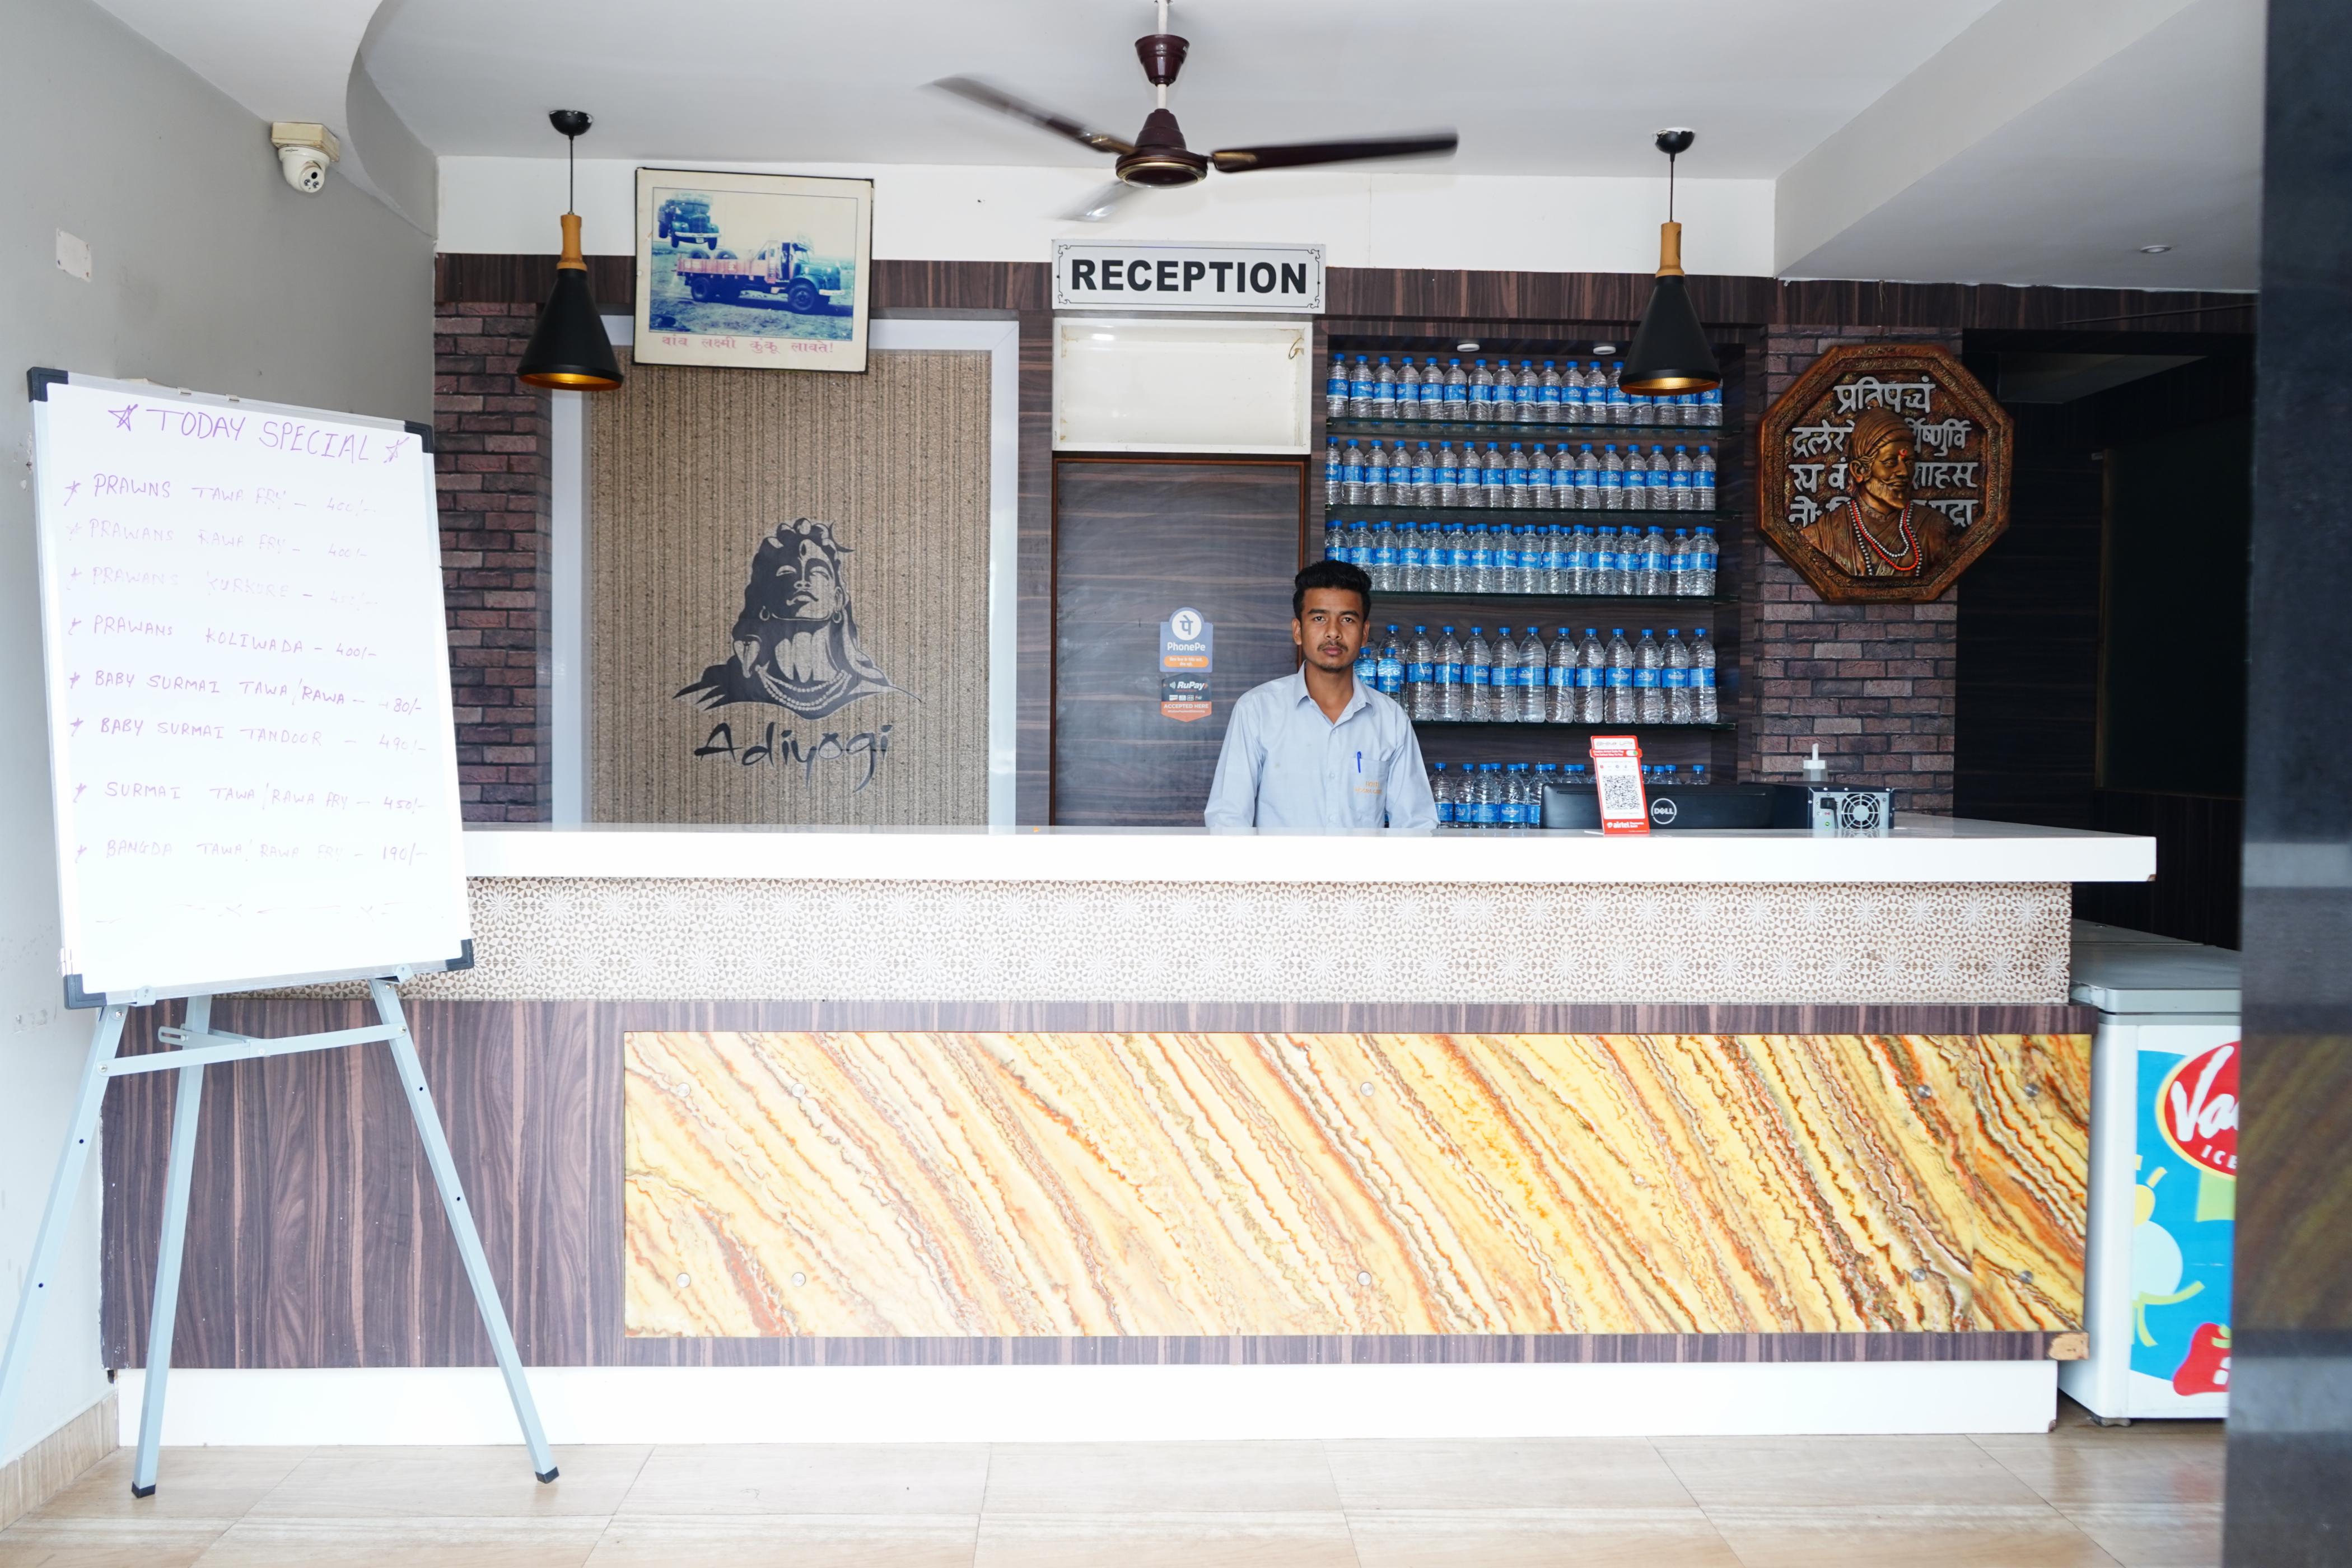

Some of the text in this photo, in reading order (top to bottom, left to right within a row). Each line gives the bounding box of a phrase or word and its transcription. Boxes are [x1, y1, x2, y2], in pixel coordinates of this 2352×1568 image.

[1072, 259, 1306, 294] RECEPTION
[146, 408, 370, 464] TODAY SPECIAL
[94, 473, 171, 498] PRAWNS
[190, 487, 244, 501] TAWA
[90, 517, 174, 542] PRAWANS
[94, 614, 173, 636] PRAWANS
[205, 627, 303, 654] KOLIWADA
[335, 642, 377, 660] 400/-
[1167, 642, 1206, 651] PhonePe
[95, 669, 135, 688] BABY
[146, 674, 220, 694] SURMAI
[1177, 681, 1205, 690] RuPay
[100, 717, 143, 736] BABY
[157, 722, 225, 740] SURMAI
[239, 728, 322, 746] TANDOOR
[694, 721, 893, 794] Adiyogi
[104, 781, 181, 800] SURMAI
[325, 791, 348, 810] FRY
[106, 839, 173, 859] BANGDA
[382, 842, 428, 866] 190/-
[2171, 1045, 2239, 1142] Va
[2201, 1144, 2238, 1170] ICE
